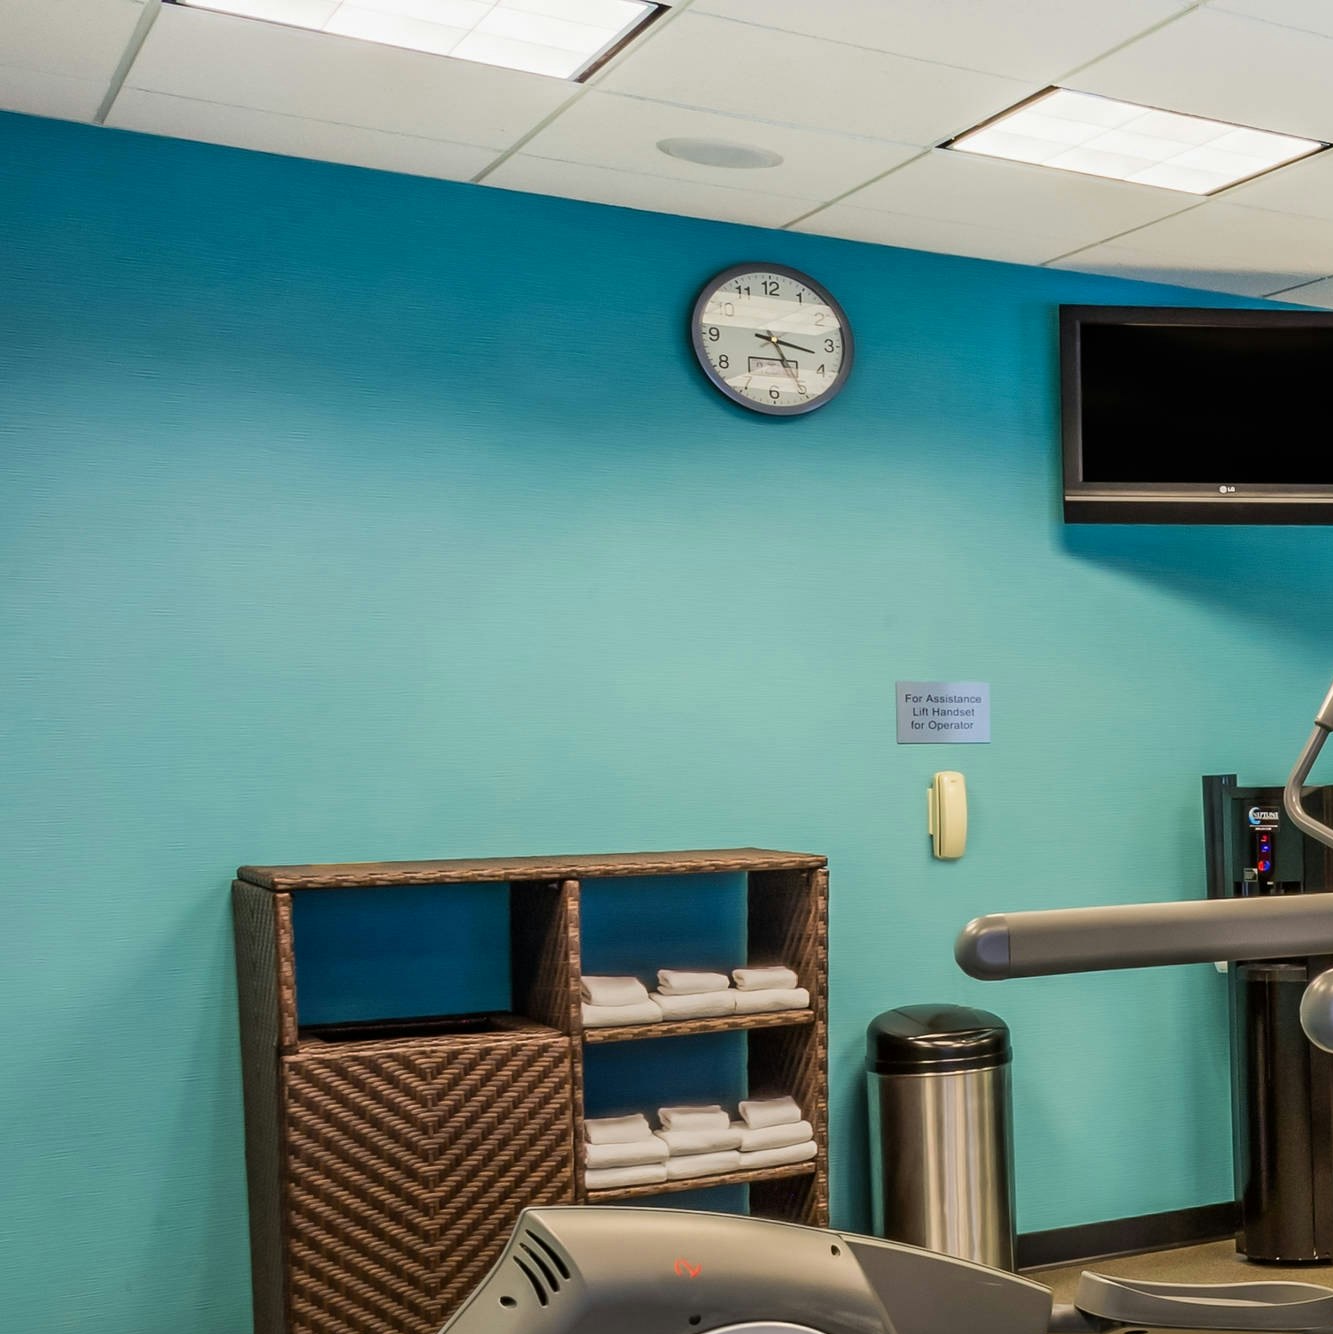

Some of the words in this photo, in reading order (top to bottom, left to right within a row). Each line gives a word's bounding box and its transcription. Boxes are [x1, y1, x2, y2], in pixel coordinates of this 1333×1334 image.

[735, 285, 751, 298] 11
[761, 281, 780, 297] 12
[796, 292, 803, 303] 1
[814, 312, 825, 327] 2
[708, 326, 720, 342] 9
[824, 338, 835, 353] 3
[718, 354, 730, 369] 8
[816, 364, 826, 378] 4
[769, 384, 780, 400] 6
[904, 693, 923, 703] For
[925, 694, 982, 704] Assistance
[912, 707, 929, 717] Lift
[932, 707, 975, 717] Handset
[911, 720, 925, 730] for
[928, 720, 974, 731] Operator
